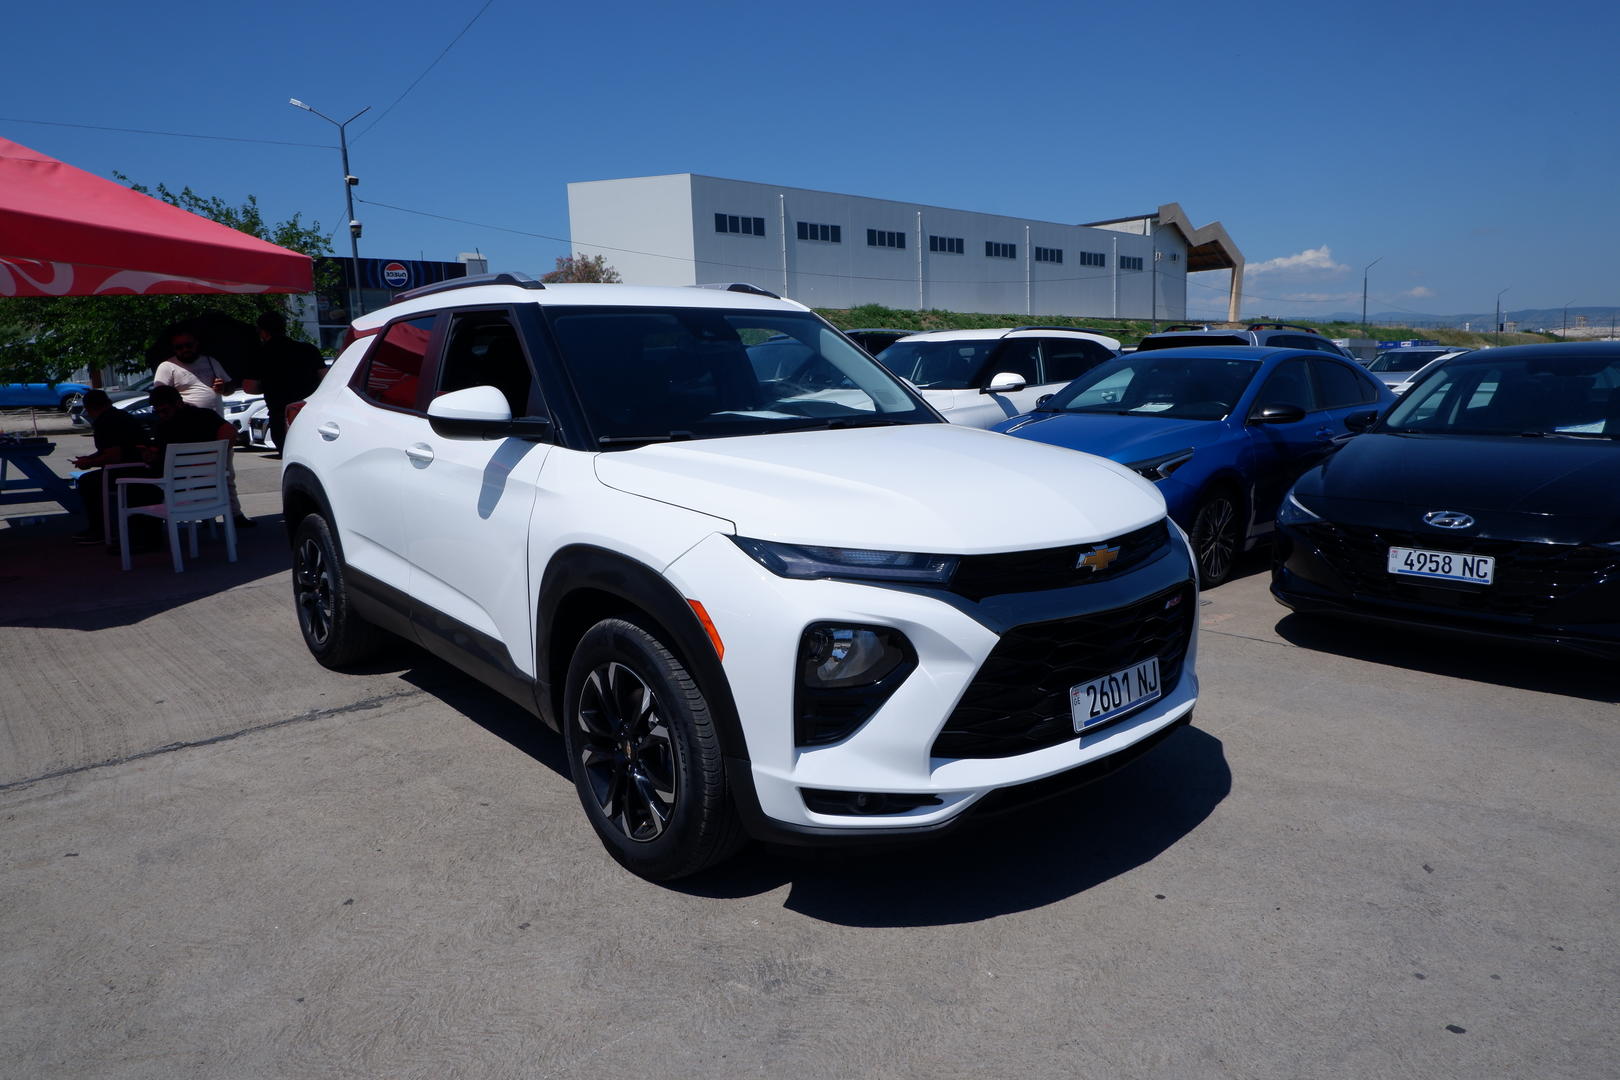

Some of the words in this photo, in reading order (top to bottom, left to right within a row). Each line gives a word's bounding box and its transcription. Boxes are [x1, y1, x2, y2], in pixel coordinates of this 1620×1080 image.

[1404, 551, 1452, 574] 4958
[1462, 556, 1488, 578] NC
[1086, 671, 1131, 718] 2601
[1137, 661, 1158, 697] NJ
